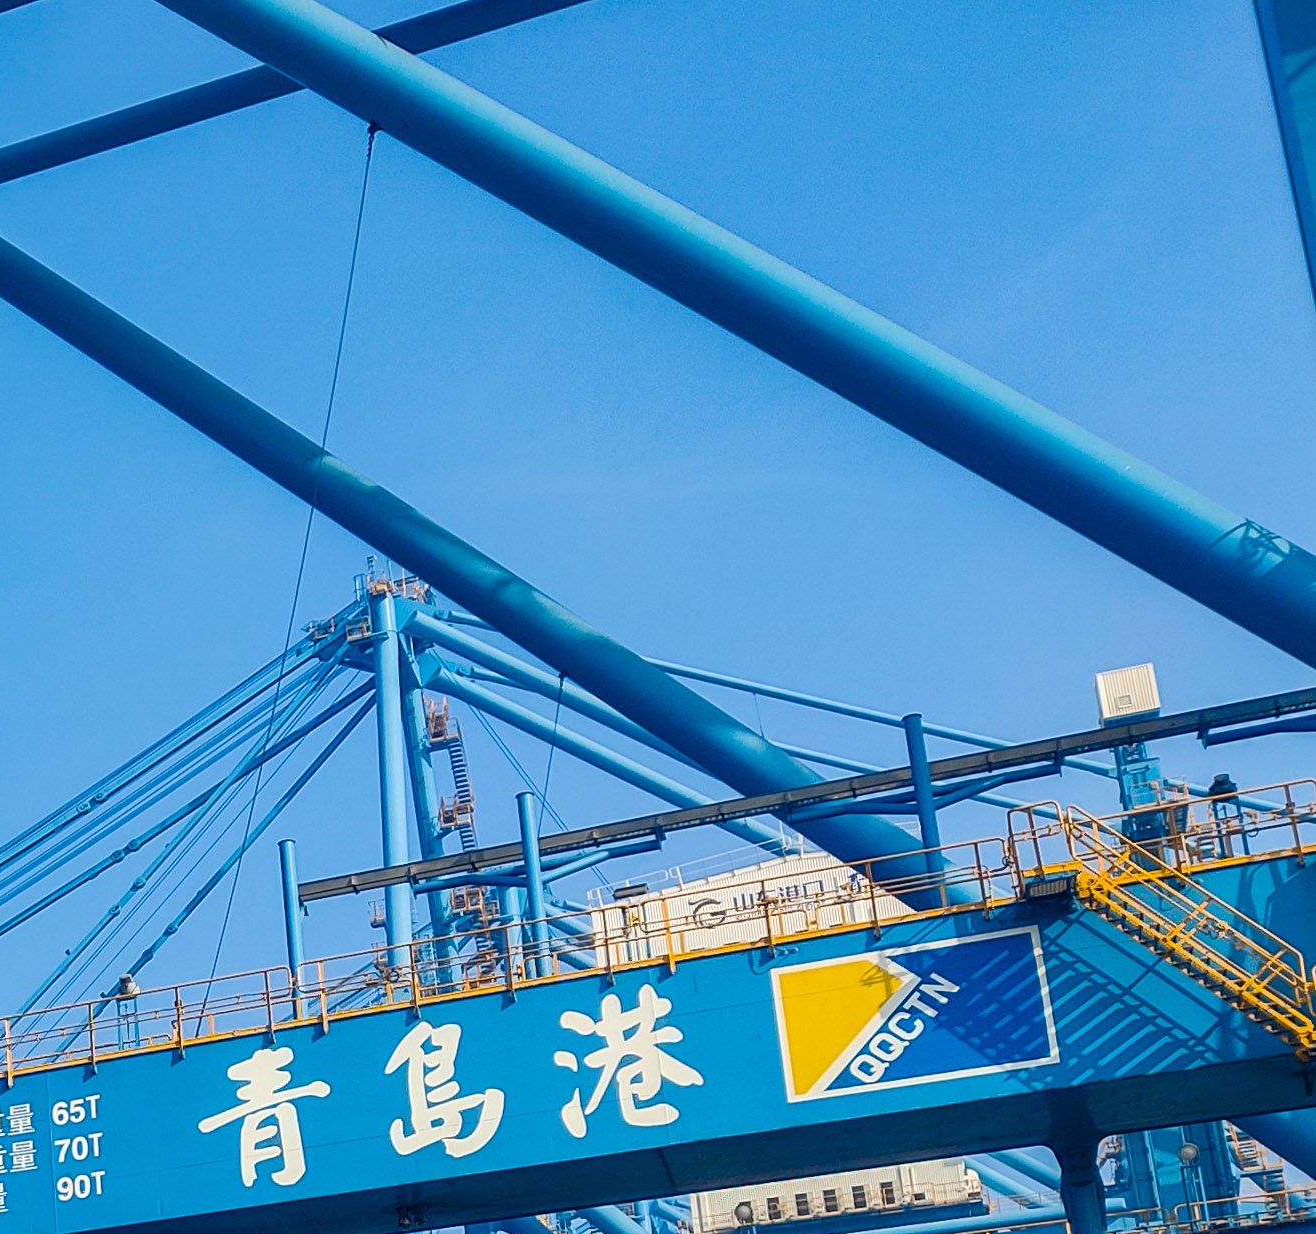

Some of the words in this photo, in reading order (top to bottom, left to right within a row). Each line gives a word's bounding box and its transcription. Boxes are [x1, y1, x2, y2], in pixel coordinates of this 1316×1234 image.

[850, 972, 962, 1086] QQCTN
[52, 1094, 101, 1126] 65T
[54, 1132, 104, 1163] 70T
[56, 1171, 106, 1202] 90T
